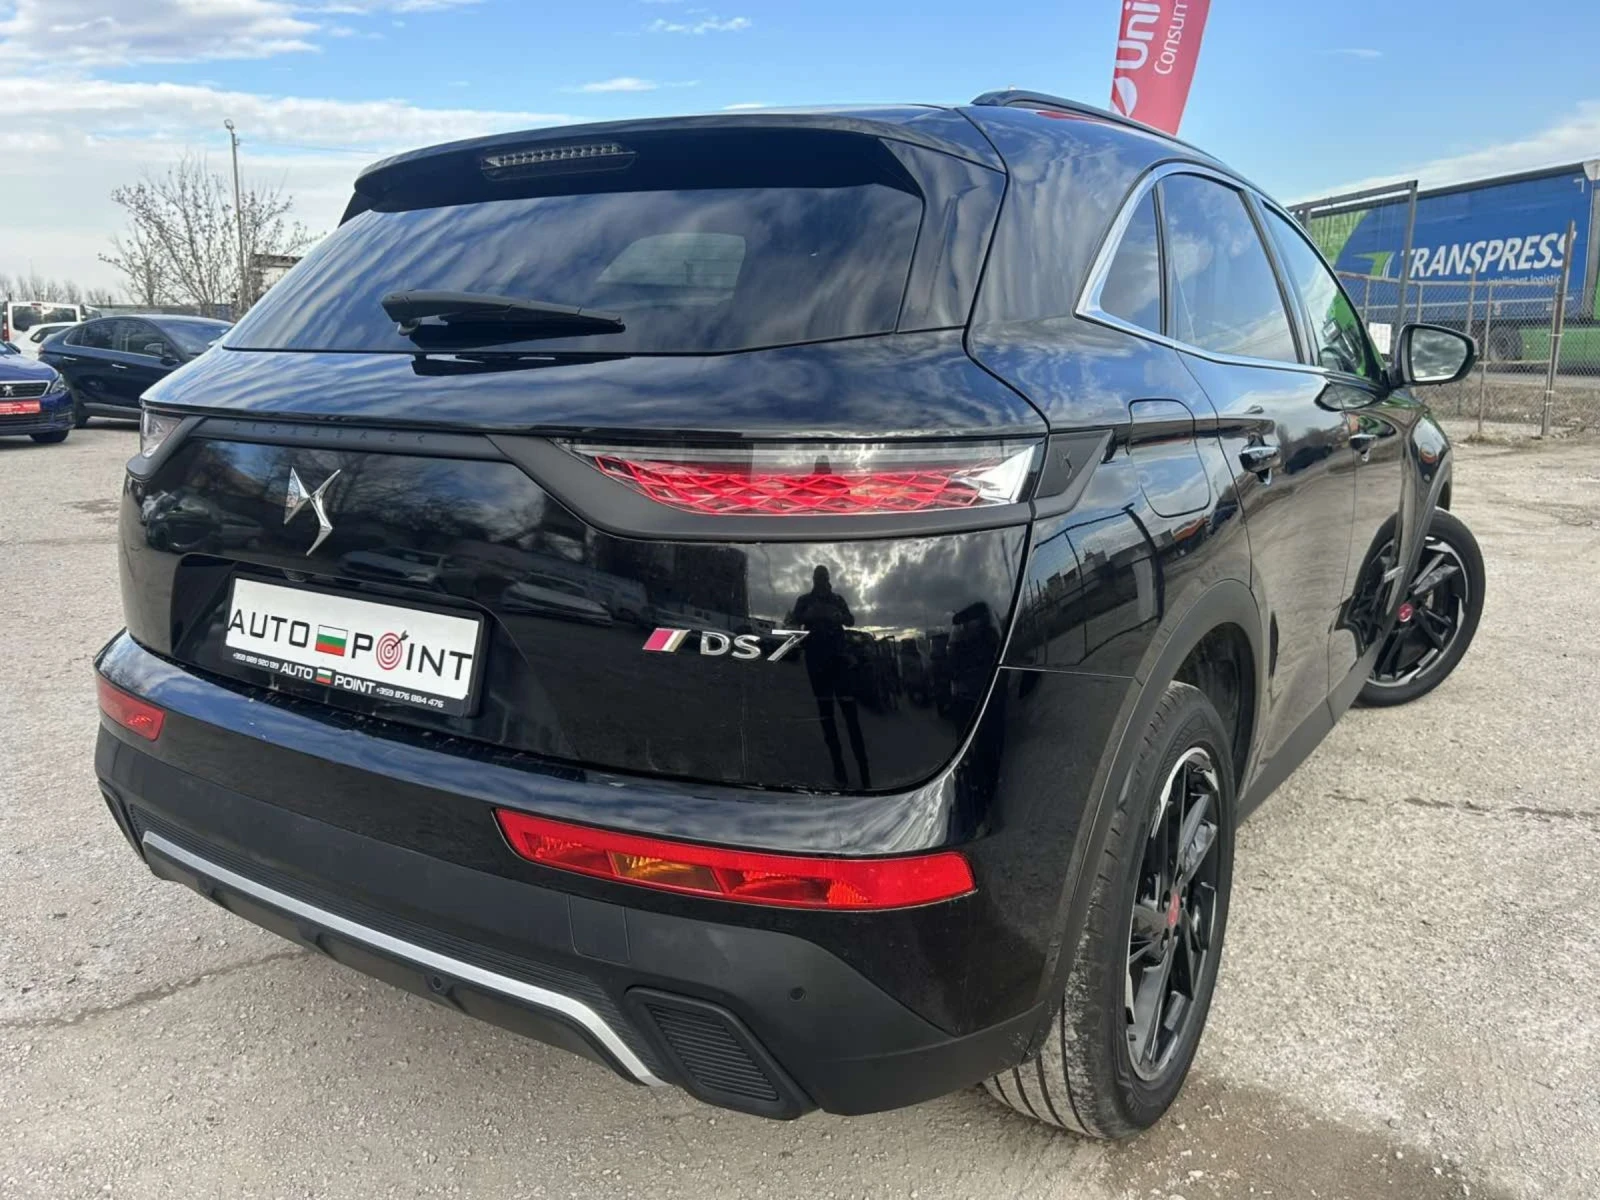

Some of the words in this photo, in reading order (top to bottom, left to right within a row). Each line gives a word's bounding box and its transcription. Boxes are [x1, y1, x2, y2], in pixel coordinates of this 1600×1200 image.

[1115, 0, 1160, 69] Uni
[227, 609, 310, 648] AUTO
[280, 662, 313, 680] AUTO
[334, 674, 376, 694] POINT
[376, 687, 394, 697] +359
